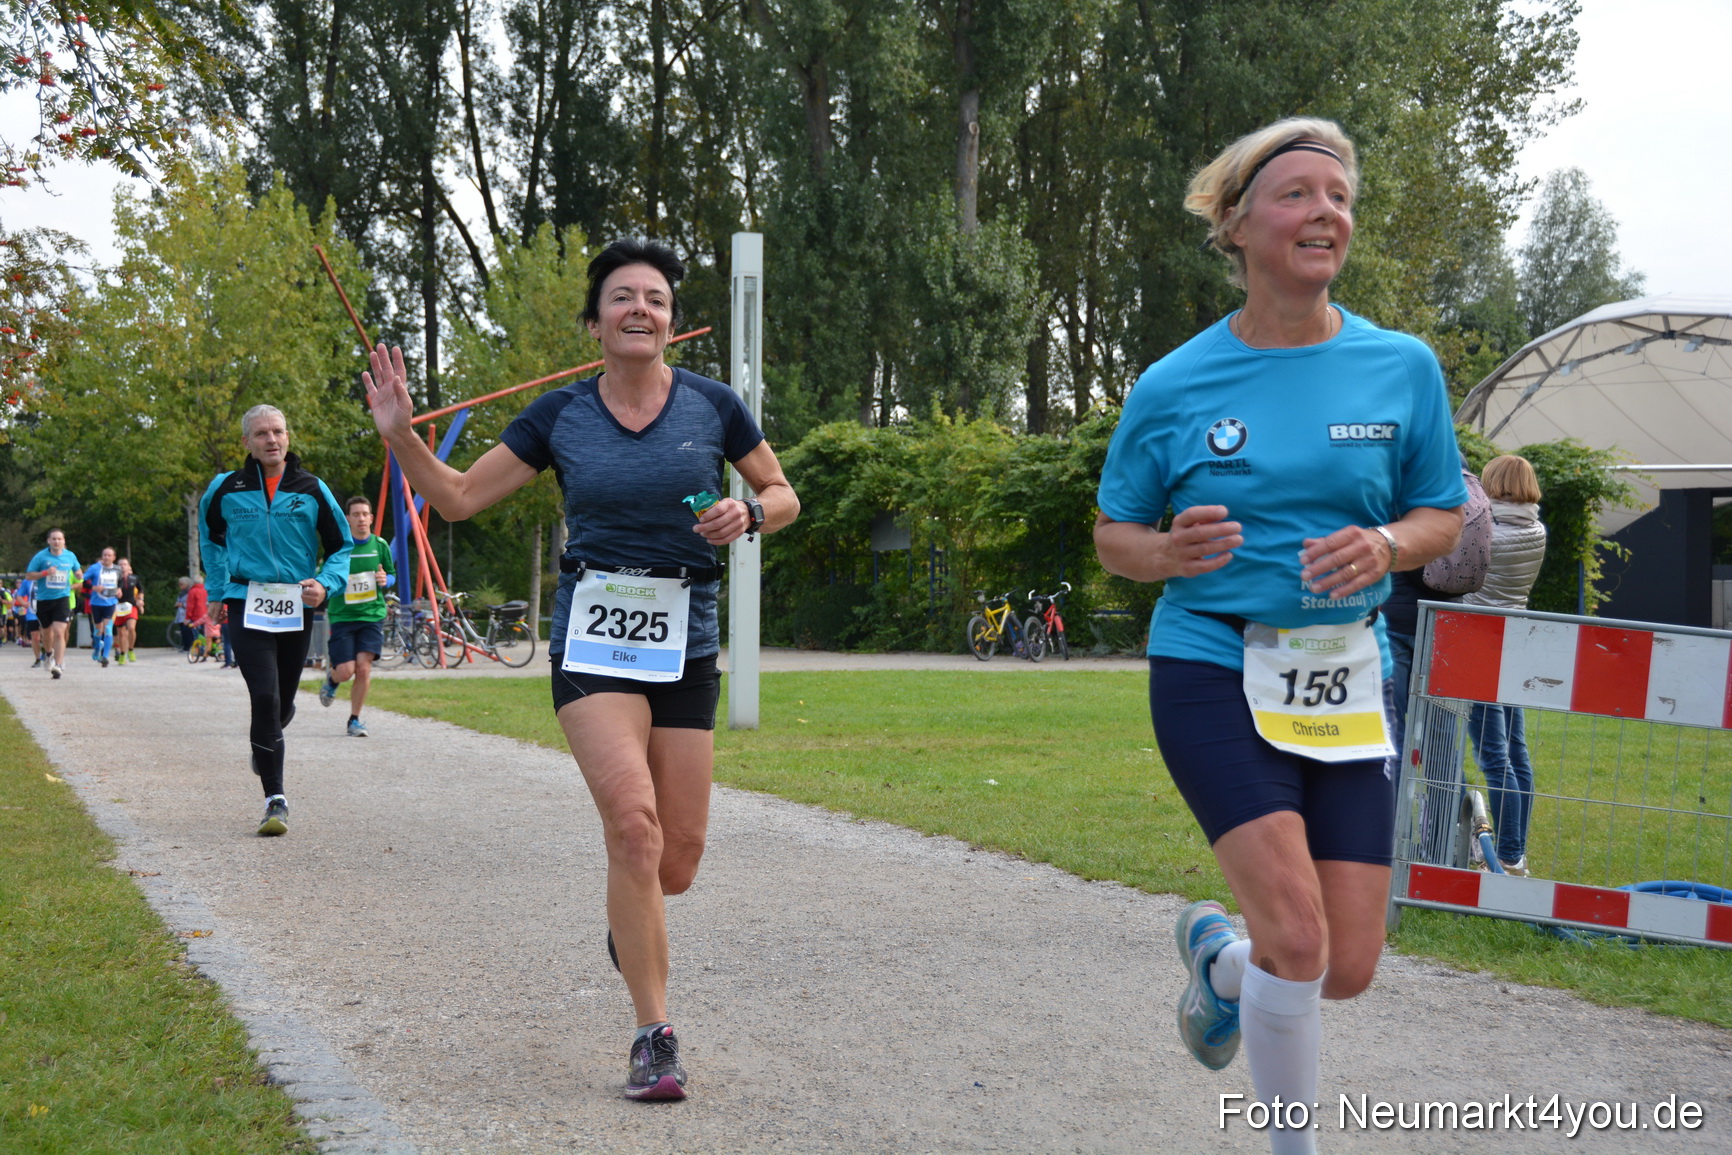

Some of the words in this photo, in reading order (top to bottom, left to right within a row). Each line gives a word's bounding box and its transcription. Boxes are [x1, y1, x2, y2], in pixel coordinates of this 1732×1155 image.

[1209, 419, 1244, 434] BMW
[1328, 424, 1398, 441] BOCK
[1208, 458, 1251, 468] PARTL
[1209, 468, 1252, 477] Neumarkt
[352, 581, 370, 592] 175
[616, 584, 657, 597] BOCK
[253, 597, 295, 616] 2348
[586, 604, 669, 643] 2325
[1305, 636, 1346, 651] BOCK
[612, 650, 637, 663] Elke
[1279, 666, 1350, 707] 158
[1292, 721, 1340, 737] Christa
